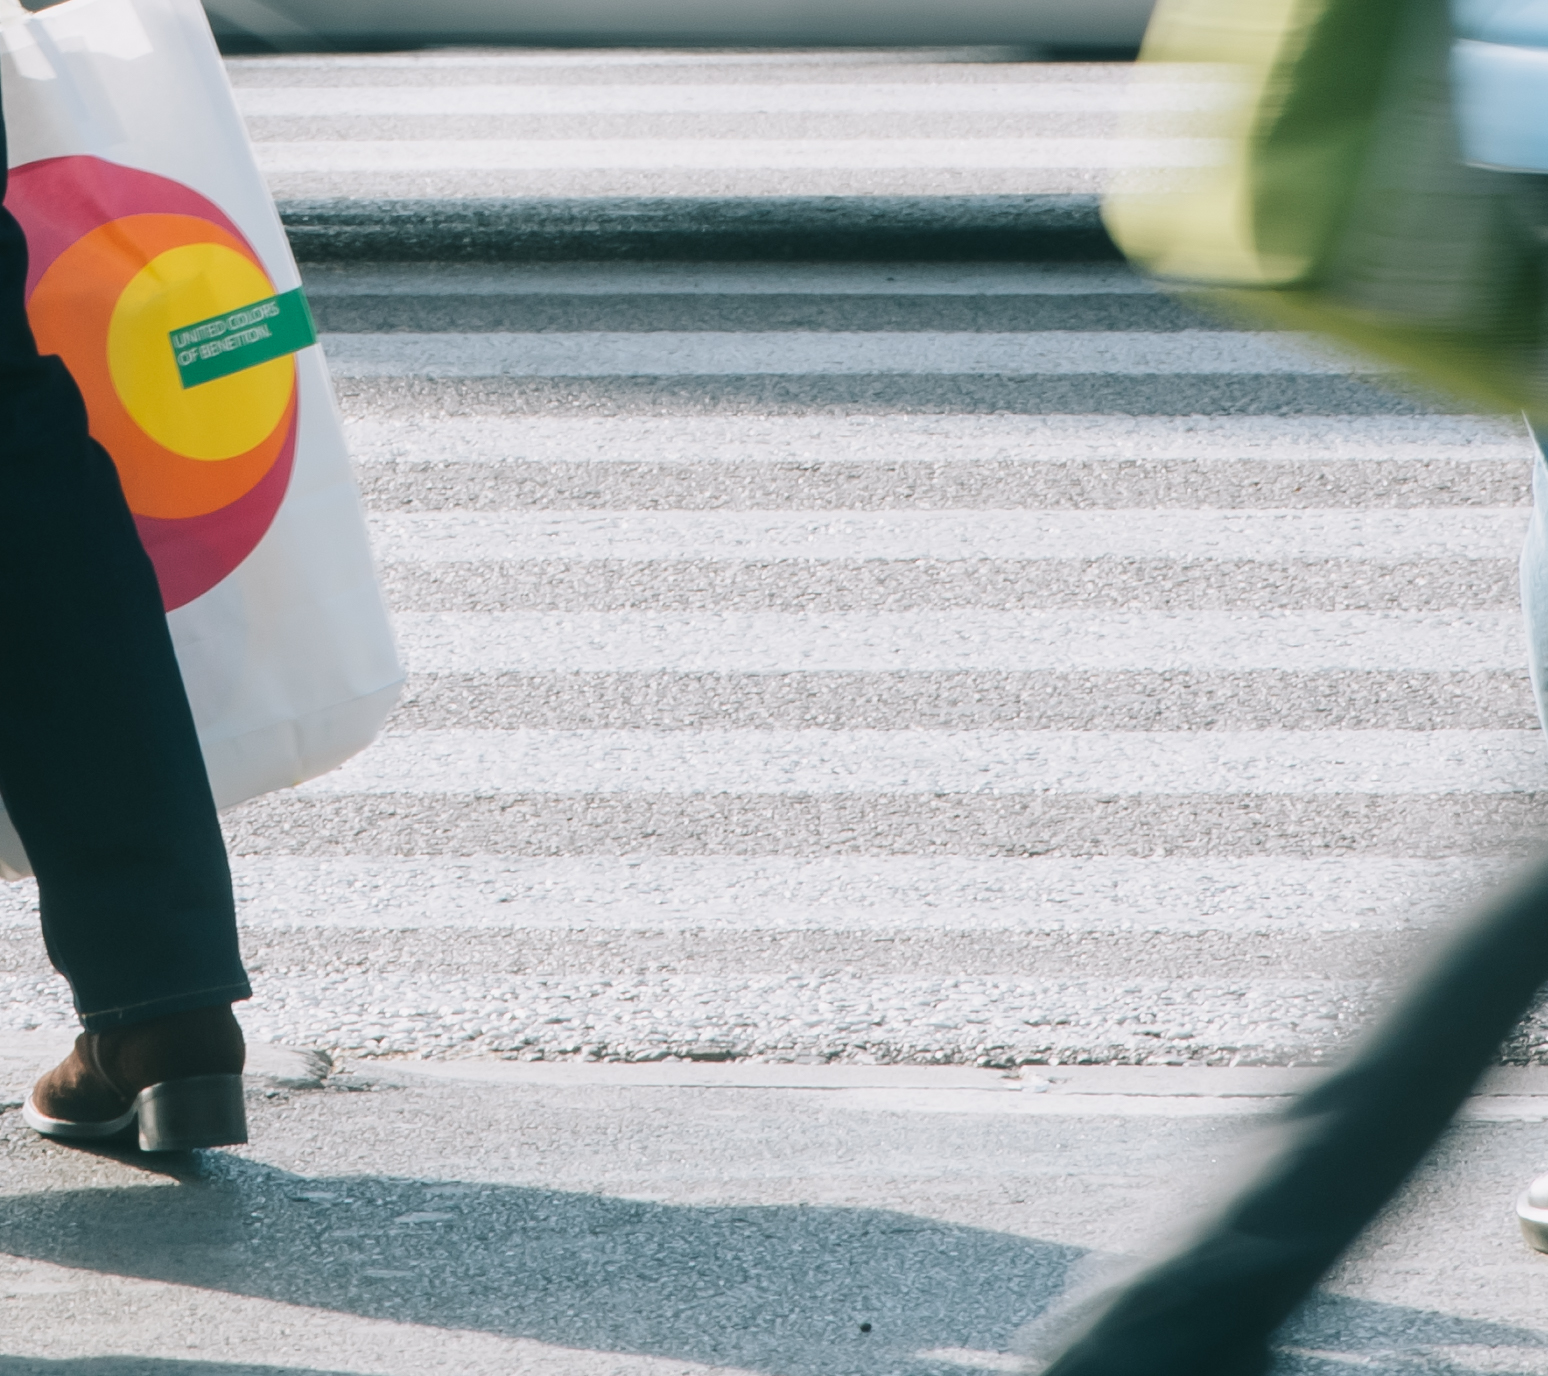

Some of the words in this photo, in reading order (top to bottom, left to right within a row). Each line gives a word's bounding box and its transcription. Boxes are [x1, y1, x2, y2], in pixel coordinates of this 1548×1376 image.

[174, 320, 227, 348] UNITED
[227, 300, 281, 331] COLORS
[177, 348, 199, 366] OF
